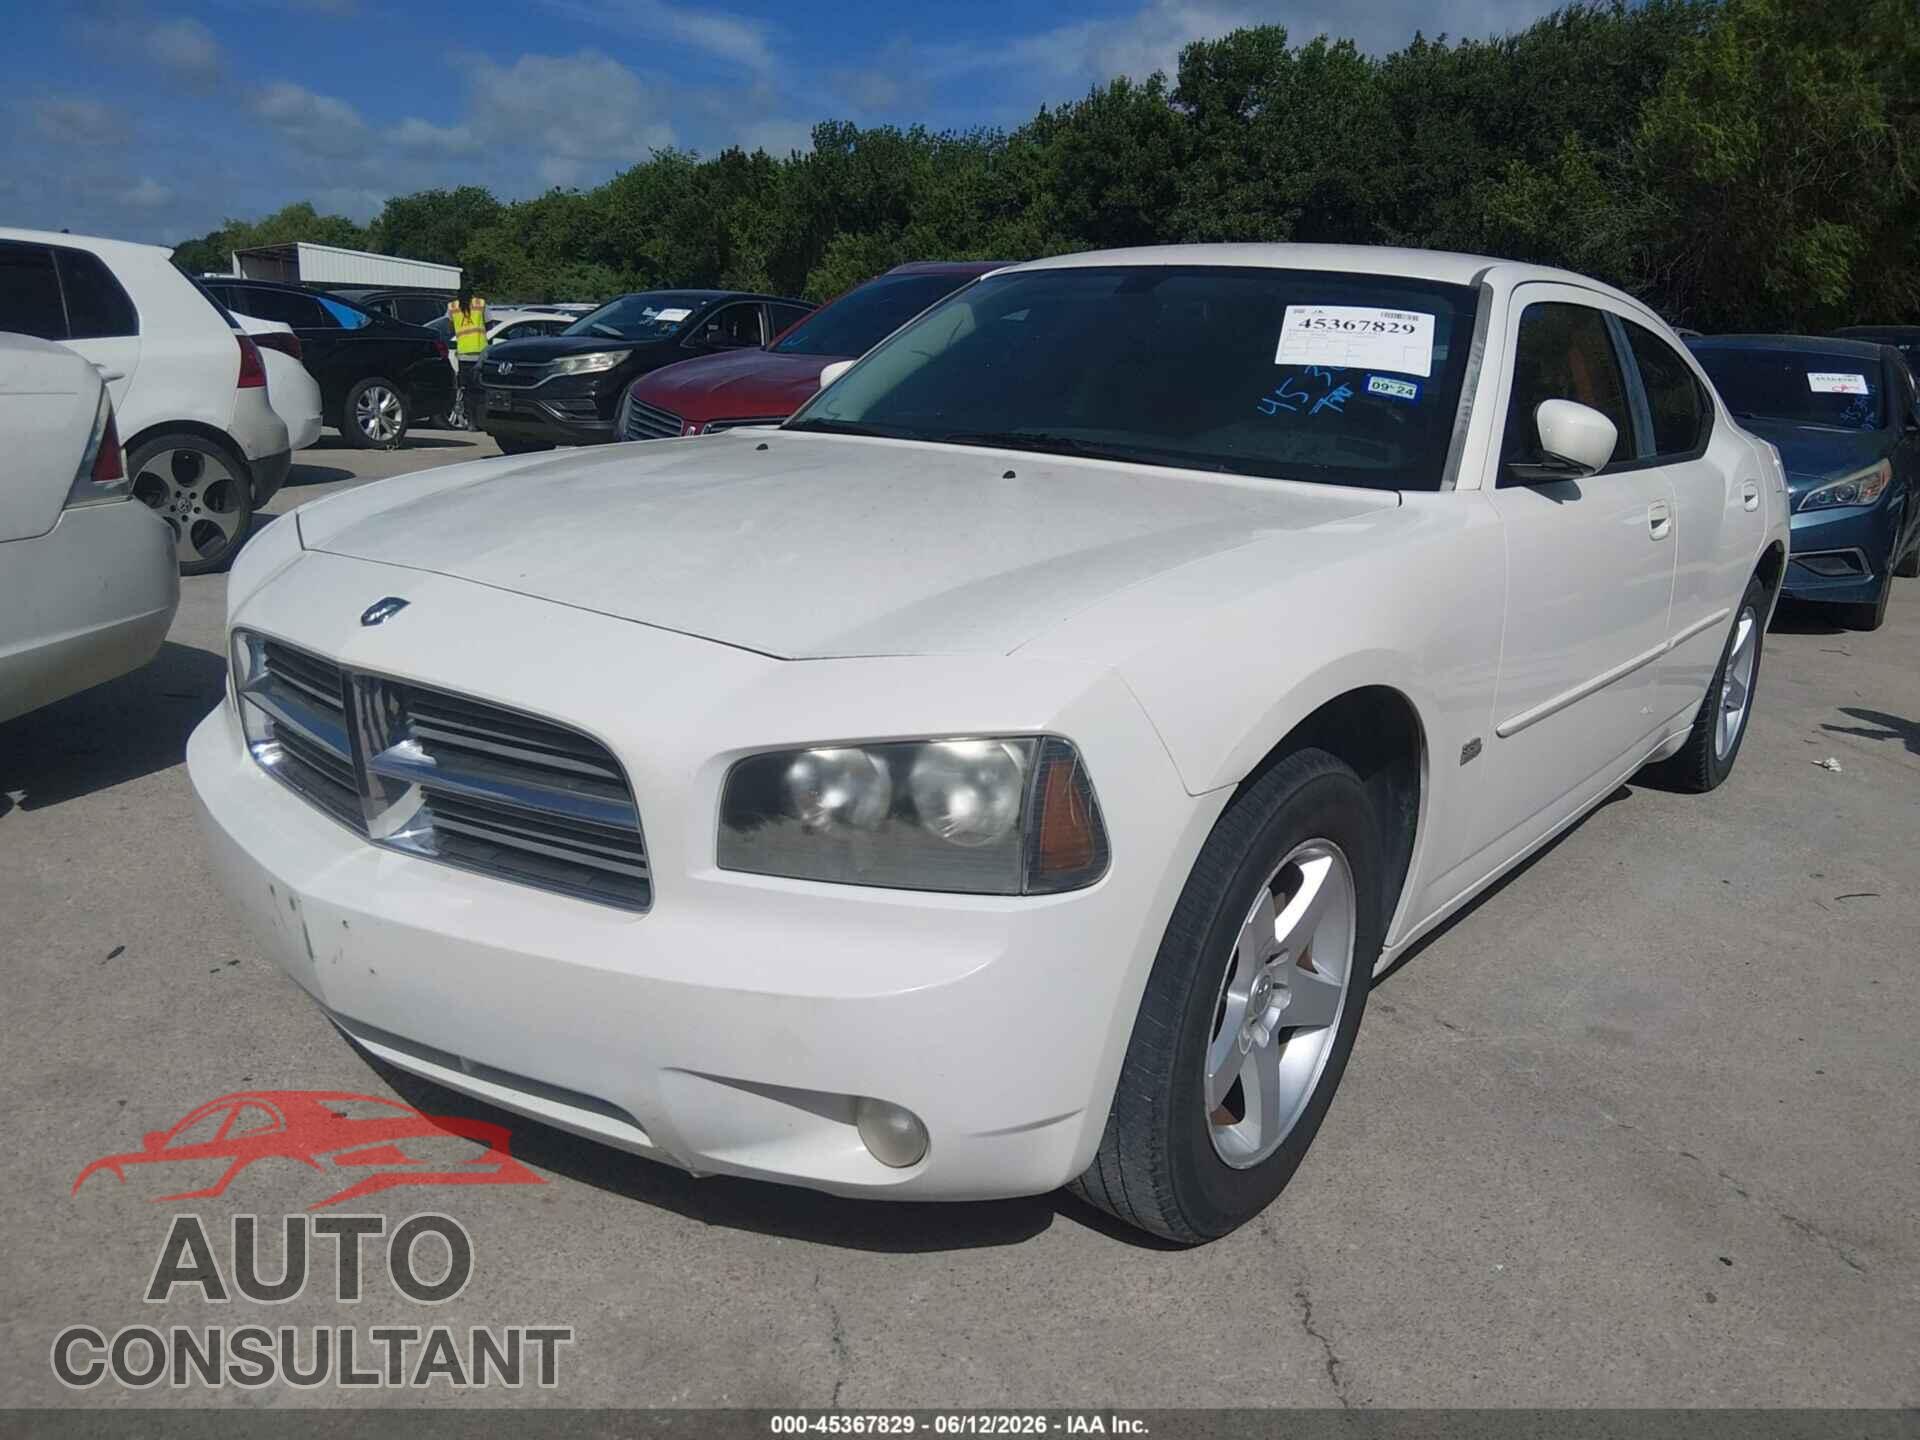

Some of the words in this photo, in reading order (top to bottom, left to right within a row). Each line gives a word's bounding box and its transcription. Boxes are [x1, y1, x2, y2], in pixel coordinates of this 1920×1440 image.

[1299, 317, 1415, 334] 45367829
[1372, 381, 1389, 391] 09
[1396, 385, 1414, 396] 24
